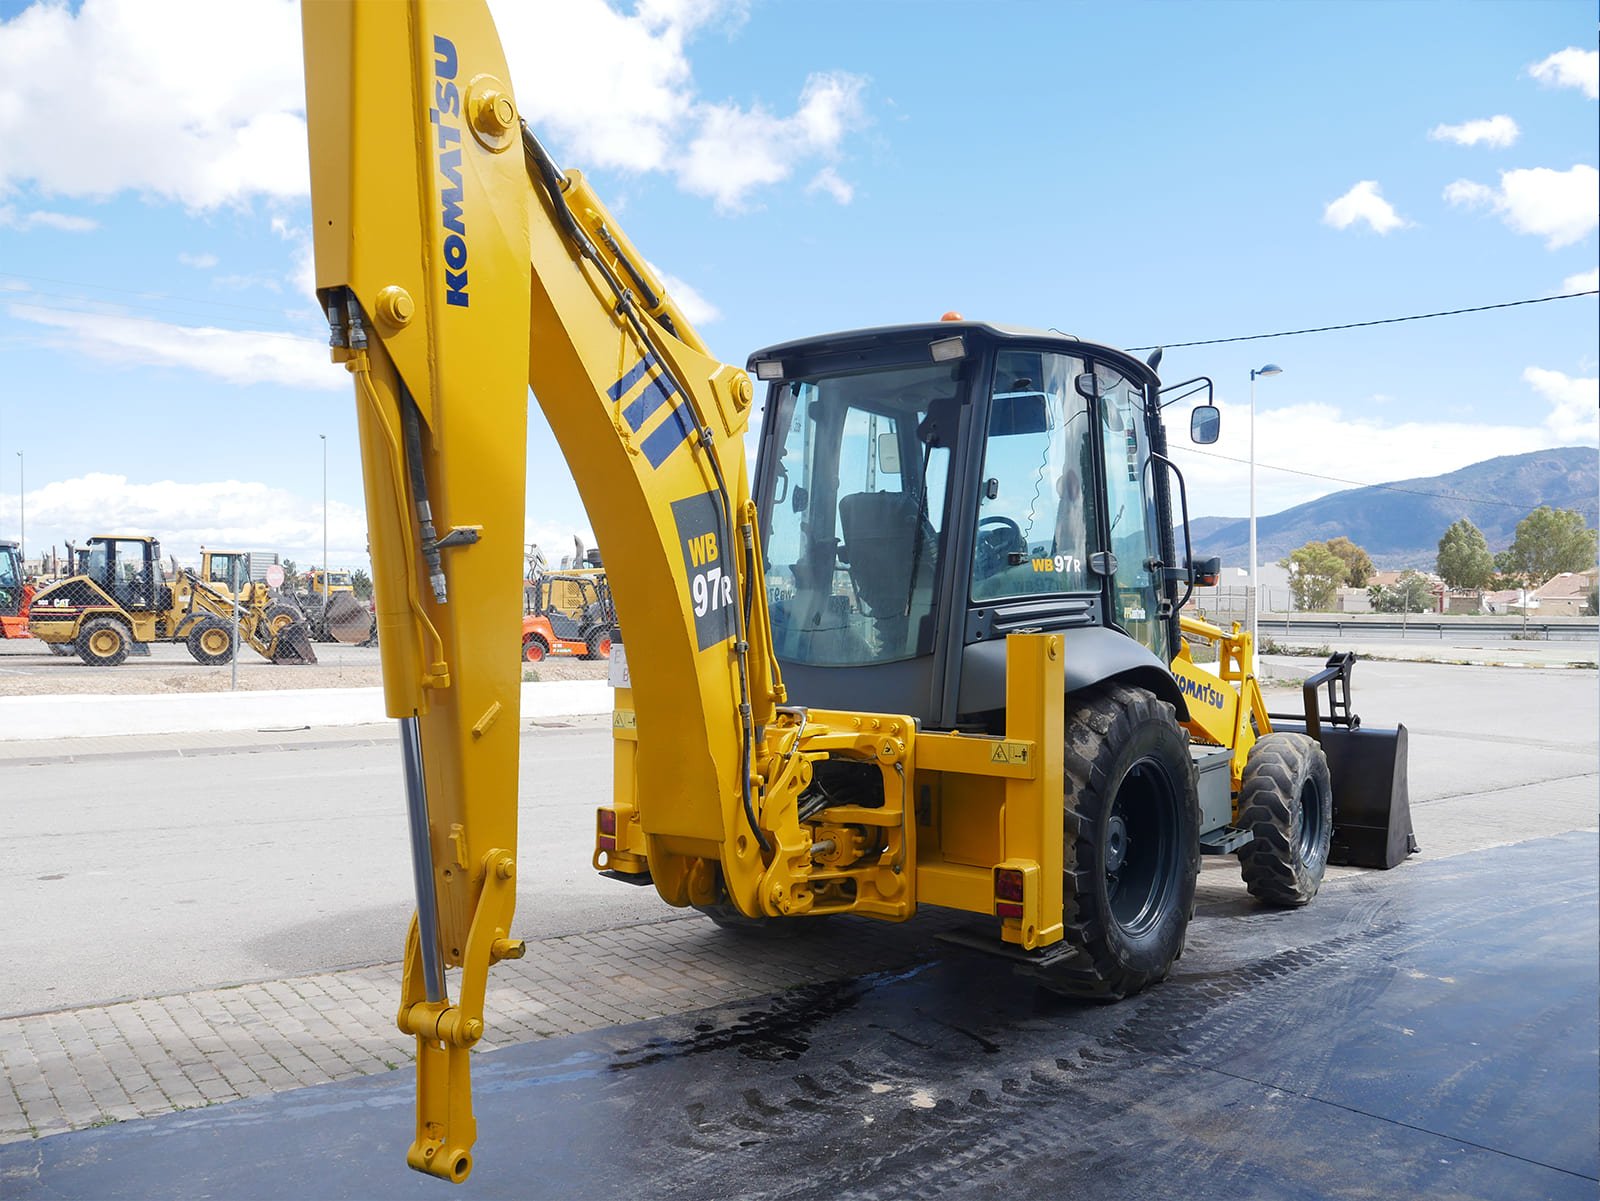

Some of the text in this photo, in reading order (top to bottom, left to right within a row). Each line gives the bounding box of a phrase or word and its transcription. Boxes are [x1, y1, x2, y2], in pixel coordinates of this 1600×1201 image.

[429, 35, 470, 308] KOMATSU
[688, 532, 719, 568] WB
[54, 598, 70, 607] CAT
[693, 567, 733, 617] 97R
